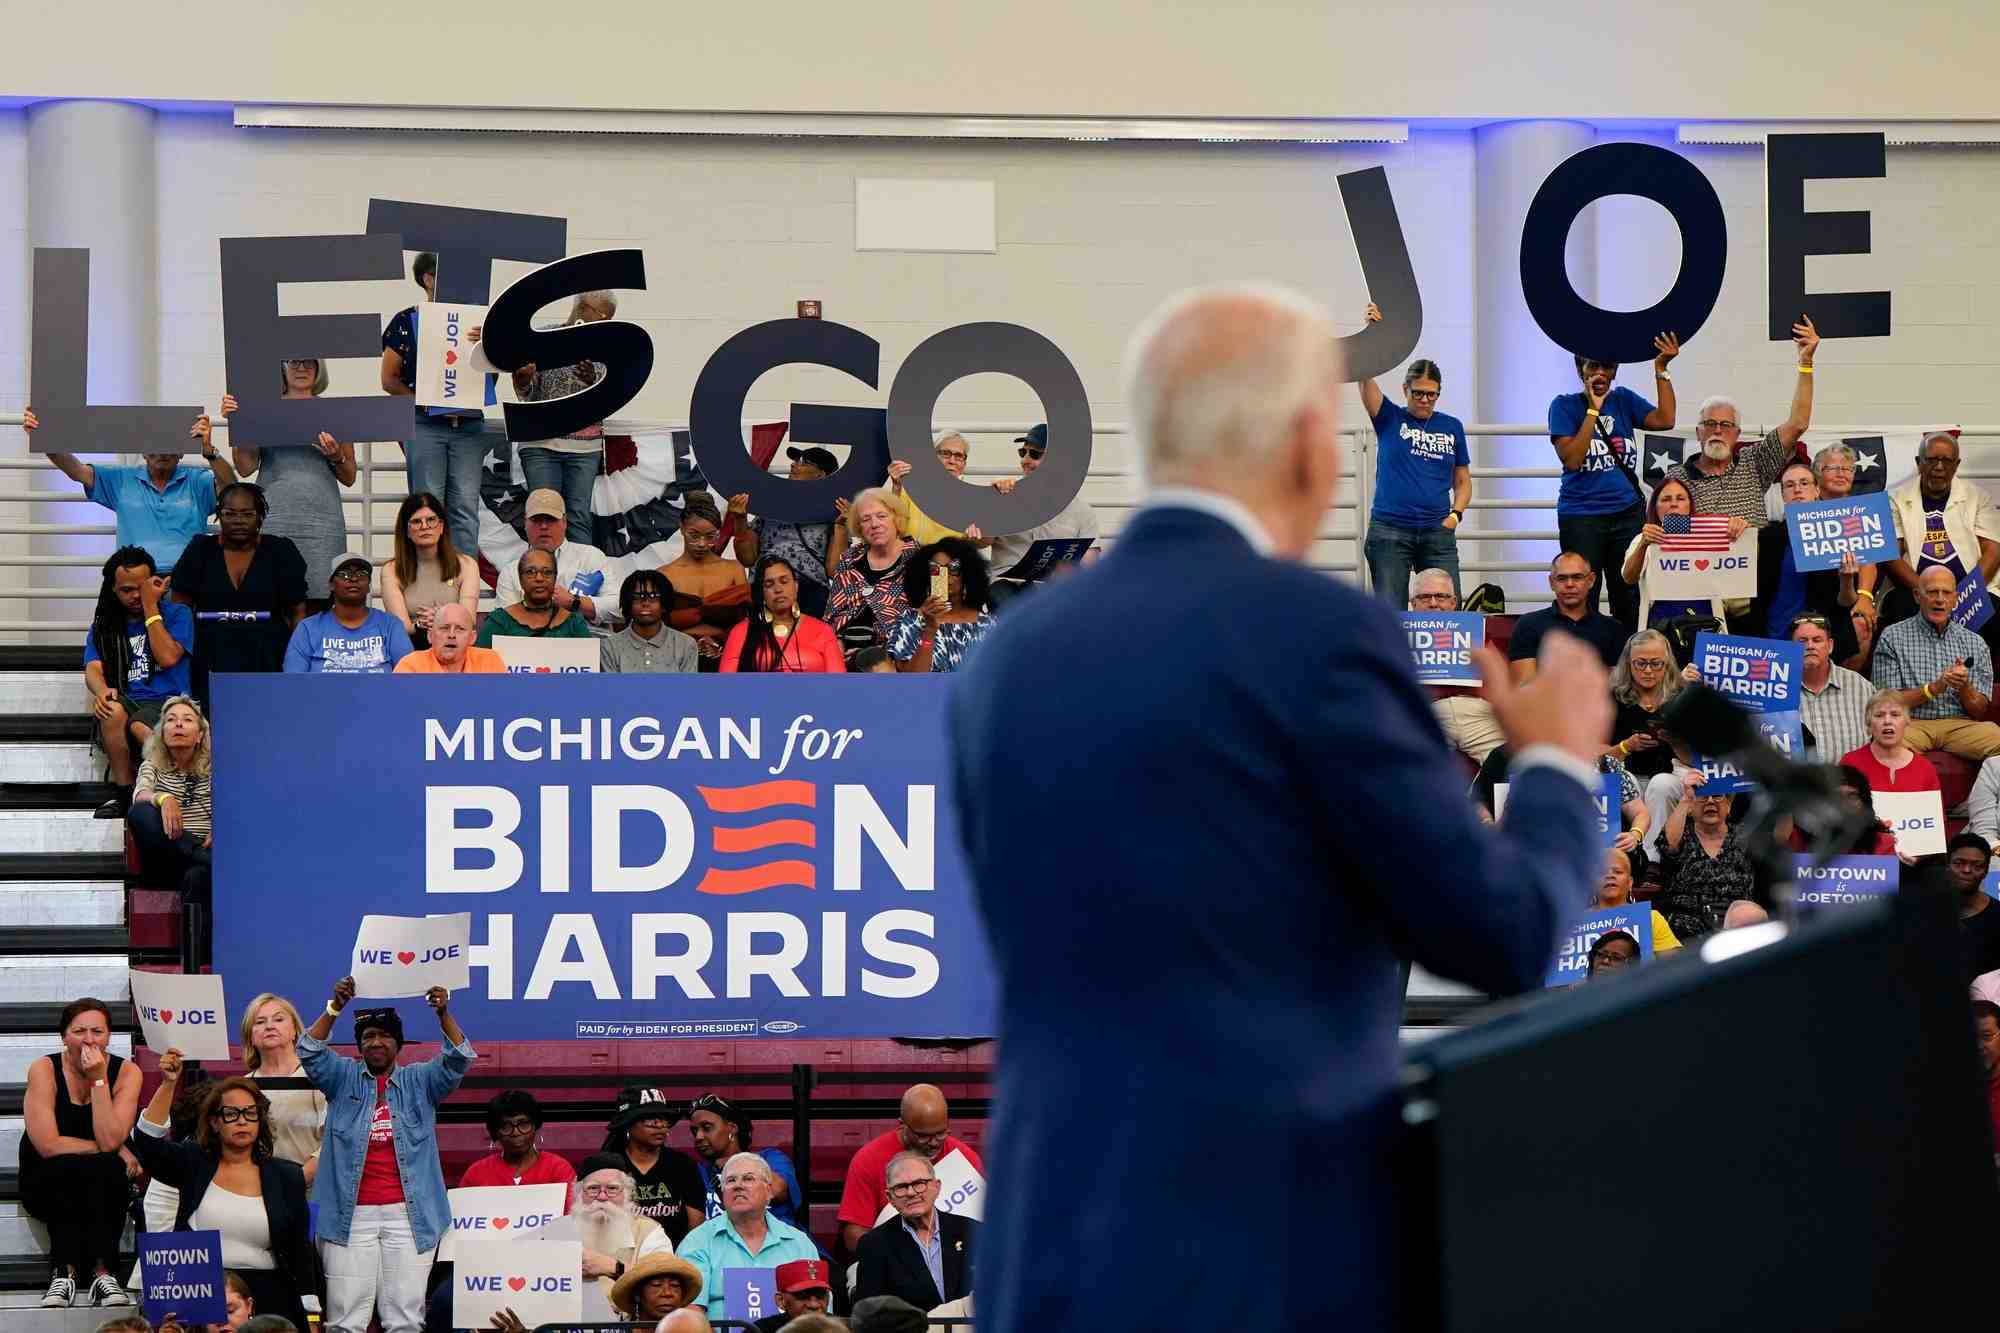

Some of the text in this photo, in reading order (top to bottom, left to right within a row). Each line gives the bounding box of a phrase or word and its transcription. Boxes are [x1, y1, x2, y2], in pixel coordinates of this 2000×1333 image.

[689, 318, 1092, 537] GO
[1335, 131, 1892, 383] JOE
[443, 312, 459, 399] WE JOE
[1411, 428, 1455, 446] BIDEN
[1412, 439, 1456, 455] HARRIS
[1585, 436, 1637, 457] IDEN
[1580, 454, 1637, 472] HARIS
[1797, 505, 1867, 521] MICHIGAN for
[1799, 513, 1882, 540] BIDEN
[1803, 532, 1885, 557] HARRIS
[1659, 556, 1749, 571] WE JOE
[1402, 620, 1460, 631] CHIGAN for
[322, 635, 383, 650] LIVE UNITED
[1407, 631, 1471, 649] IDEN
[1408, 650, 1472, 665] ARRIS
[1706, 643, 1779, 660] MICHIGAN for
[1704, 654, 1790, 682] BIDEN
[1703, 675, 1788, 699] HARRIS
[424, 715, 863, 775] MICHIGAN for
[1898, 817, 1935, 830] JOE
[425, 780, 936, 894] BIDEN
[1797, 867, 1886, 881] MOTOWN
[1836, 881, 1847, 892] is
[1612, 916, 1628, 929] for
[360, 944, 460, 965] WE JOE
[140, 1005, 217, 1025] WE JOE
[579, 1022, 755, 1036] PAID for by BIDEN FOR PRESIDENT
[944, 1180, 979, 1213] JOE
[452, 1214, 553, 1230] WE JOE
[145, 1248, 209, 1266] MOTOWN
[167, 1268, 175, 1282] is
[149, 1283, 213, 1300] JOETOWN
[464, 1276, 572, 1292] WE JOE
